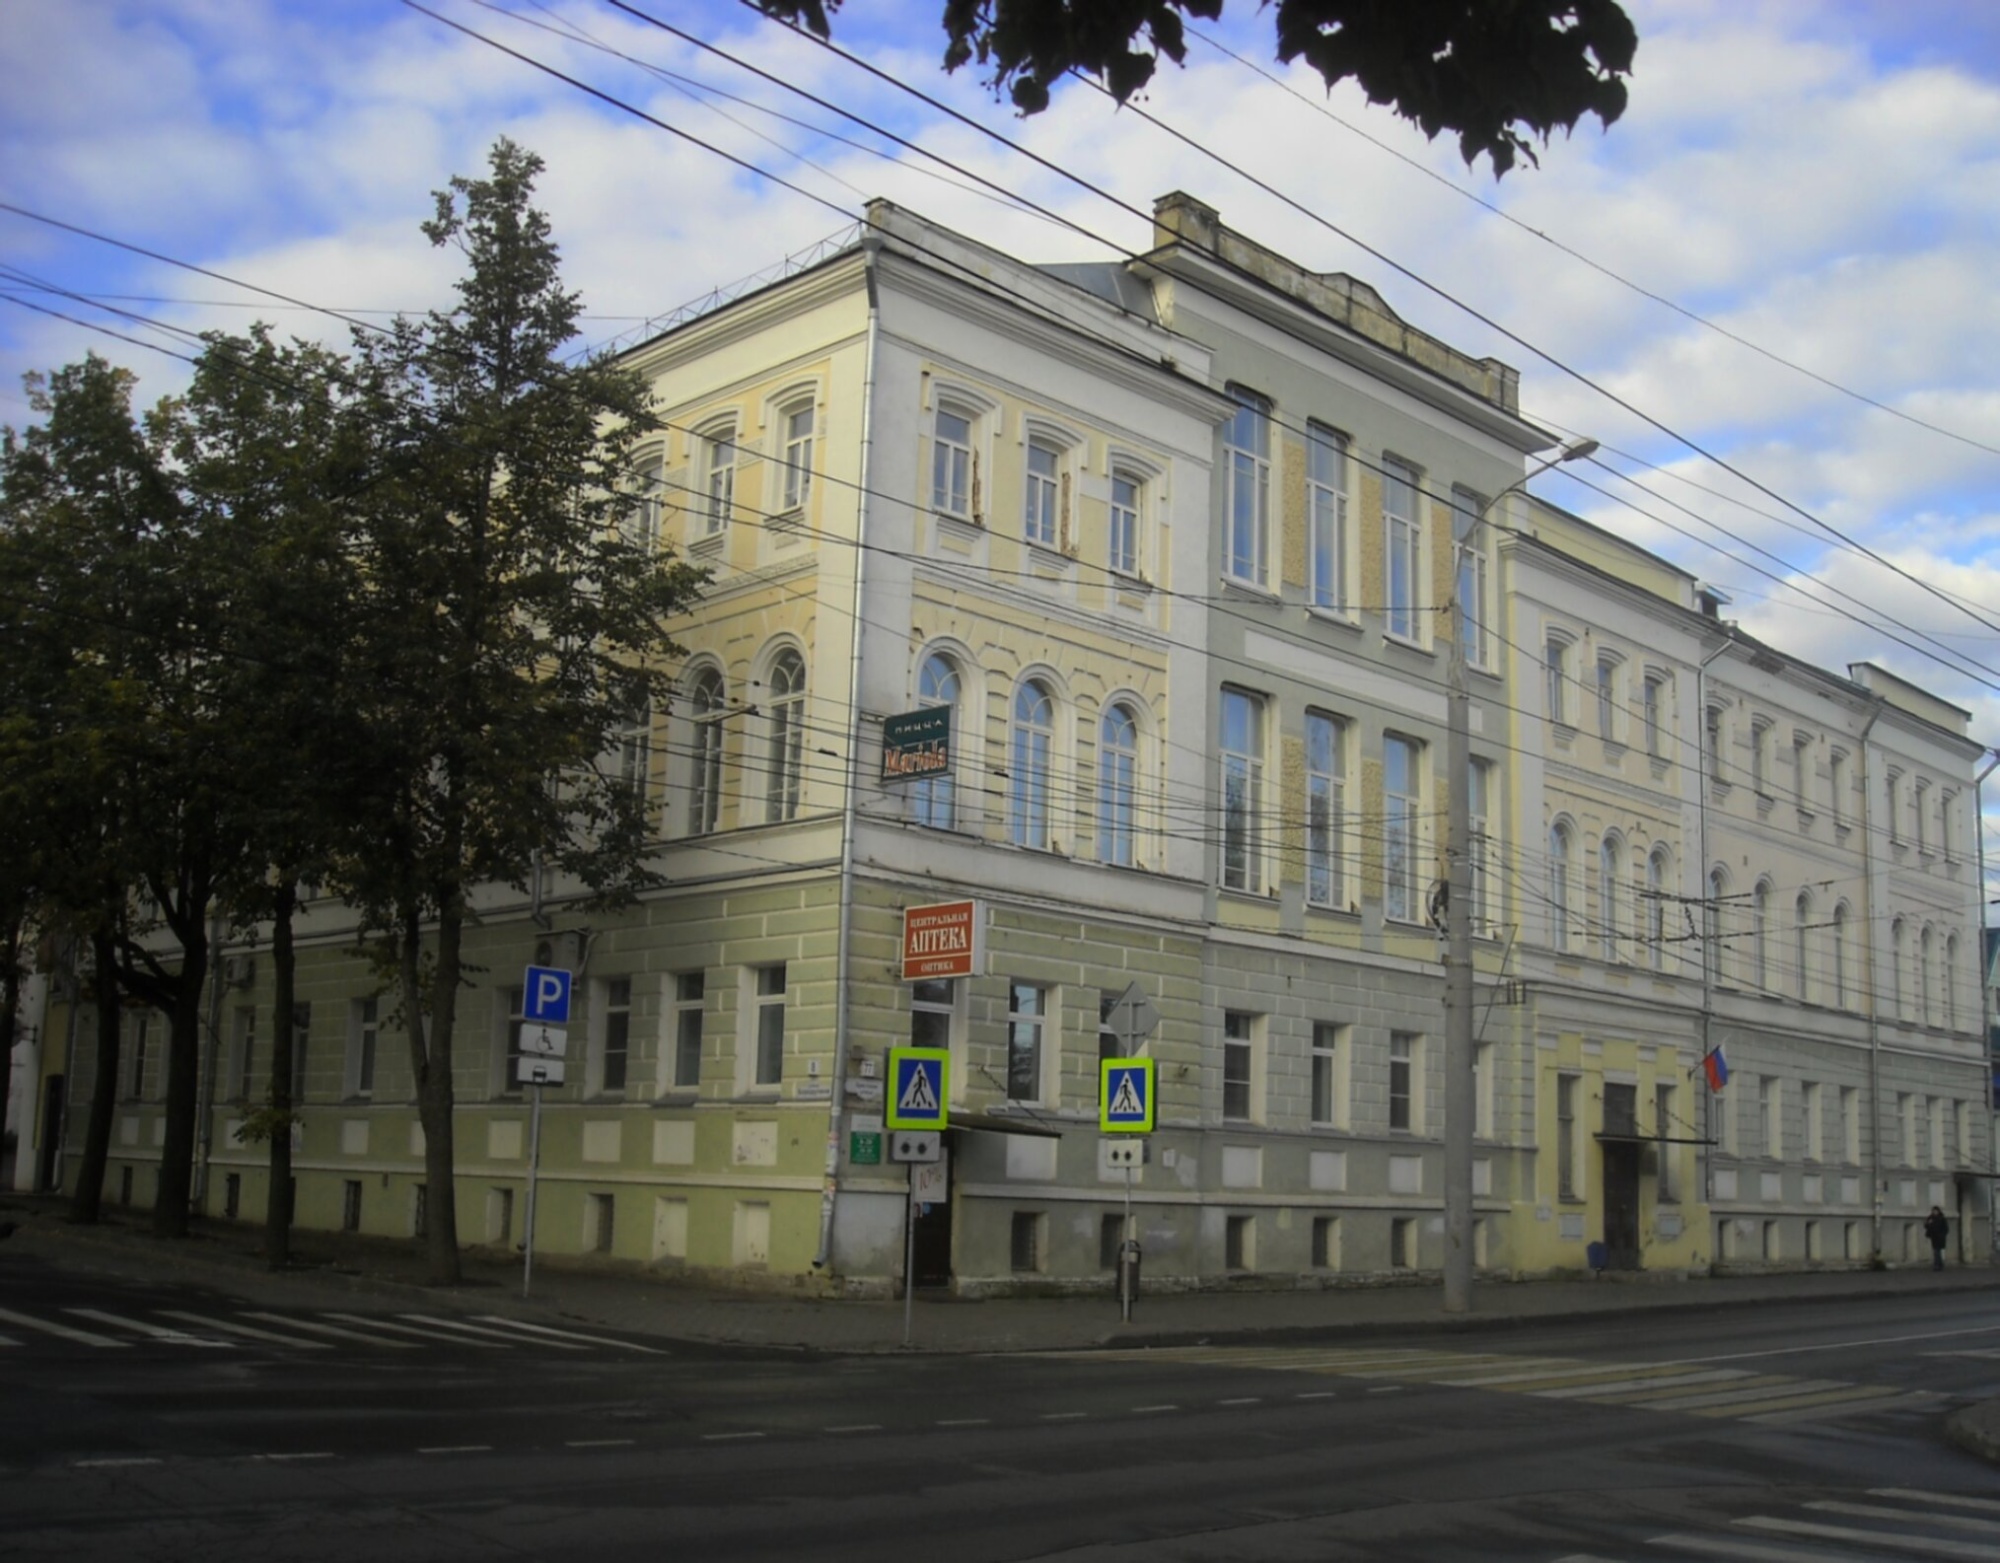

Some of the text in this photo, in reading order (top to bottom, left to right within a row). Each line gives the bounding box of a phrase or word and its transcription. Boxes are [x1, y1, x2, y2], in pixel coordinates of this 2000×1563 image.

[910, 912, 969, 928] ЦЕНТРАЛЬНАЯ
[909, 926, 967, 953] АПТЕКА
[921, 961, 954, 973] ОПТИКА
[536, 973, 562, 1015] P
